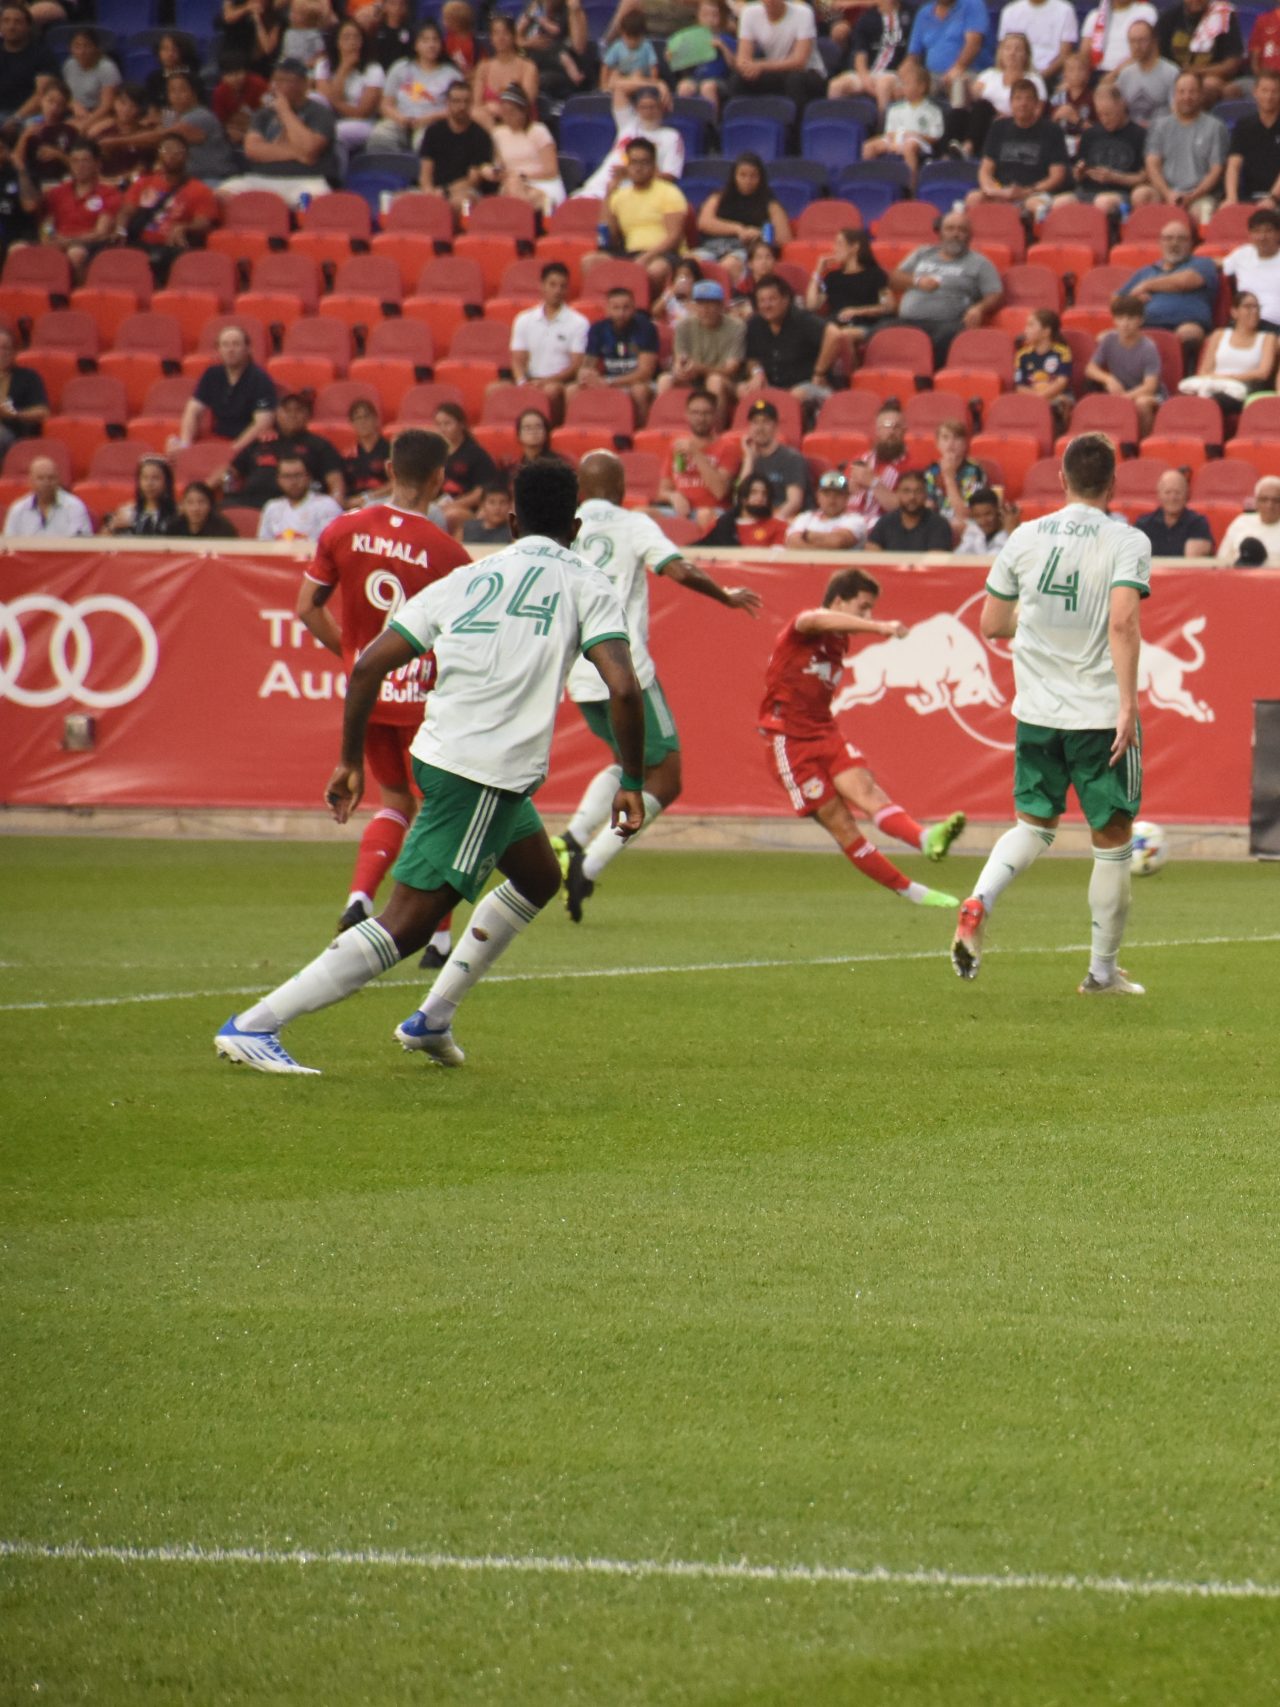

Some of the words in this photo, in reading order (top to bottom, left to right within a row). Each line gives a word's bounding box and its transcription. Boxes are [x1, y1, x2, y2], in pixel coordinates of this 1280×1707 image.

[351, 533, 428, 568] KLIMALA
[1037, 519, 1100, 538] WILSON
[365, 568, 407, 640] 9
[450, 566, 560, 636] 24
[1037, 546, 1080, 612] 4
